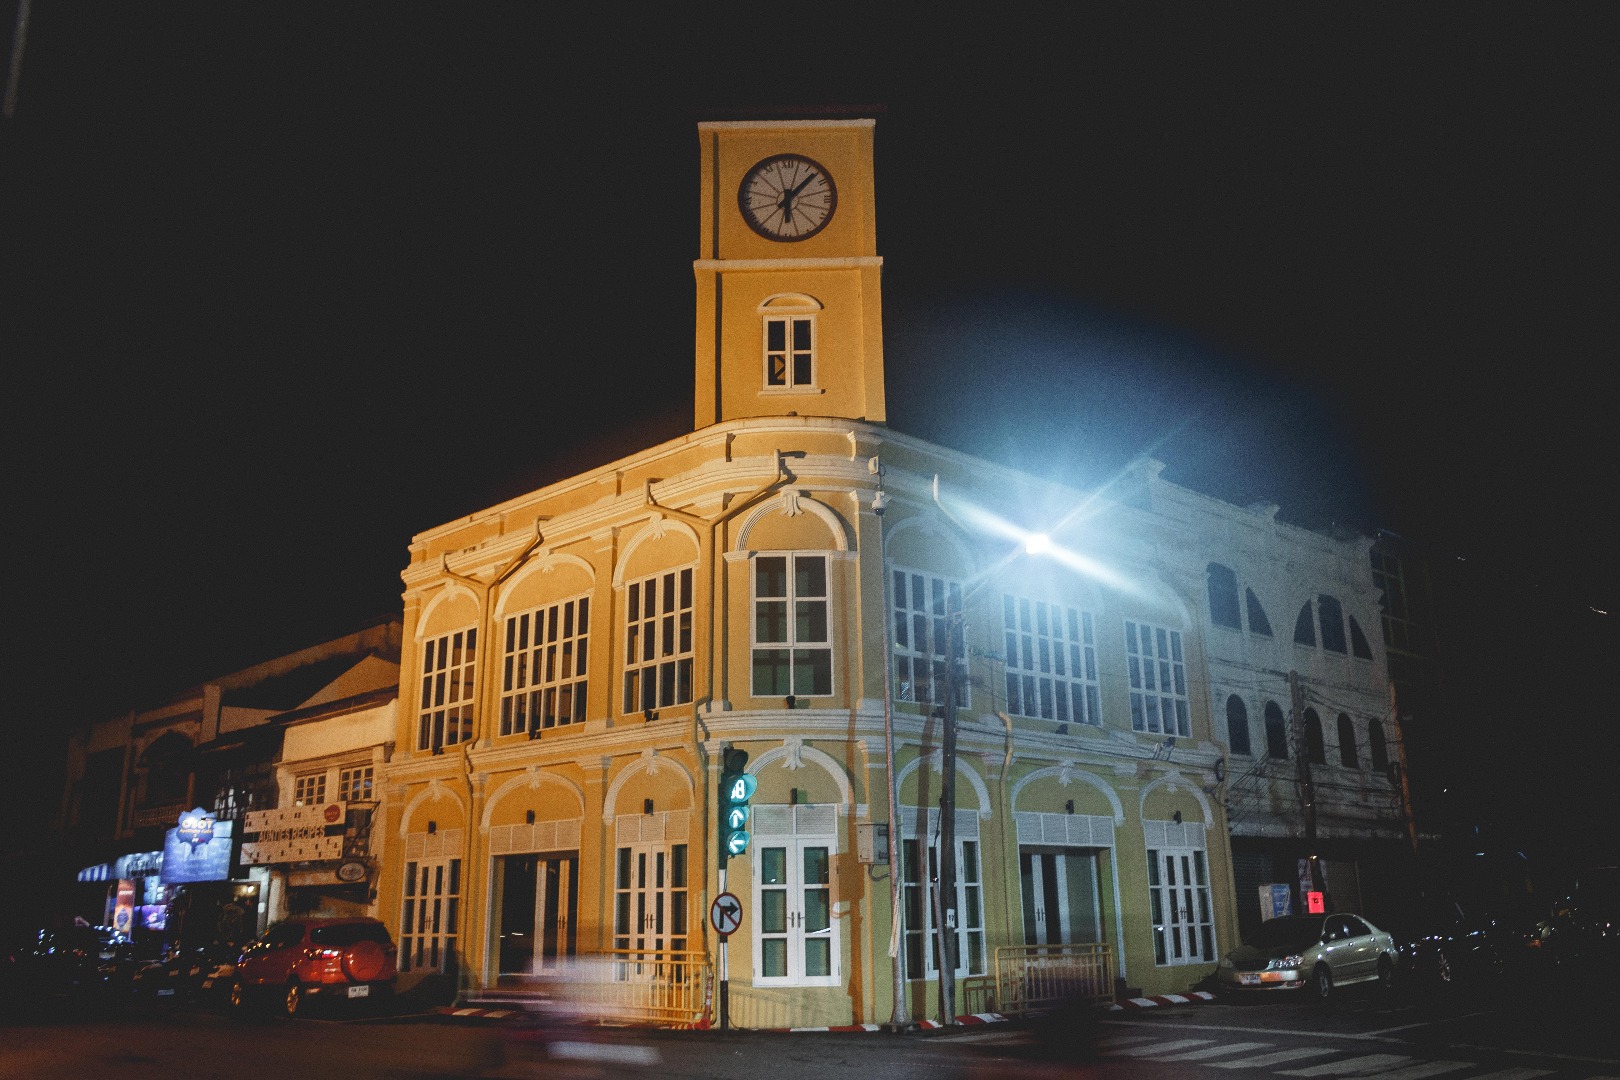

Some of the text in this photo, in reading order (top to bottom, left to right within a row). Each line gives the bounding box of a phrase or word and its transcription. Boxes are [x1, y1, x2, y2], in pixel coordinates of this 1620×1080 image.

[781, 160, 794, 169] XII
[823, 194, 832, 203] III
[292, 825, 326, 840] RECIPES
